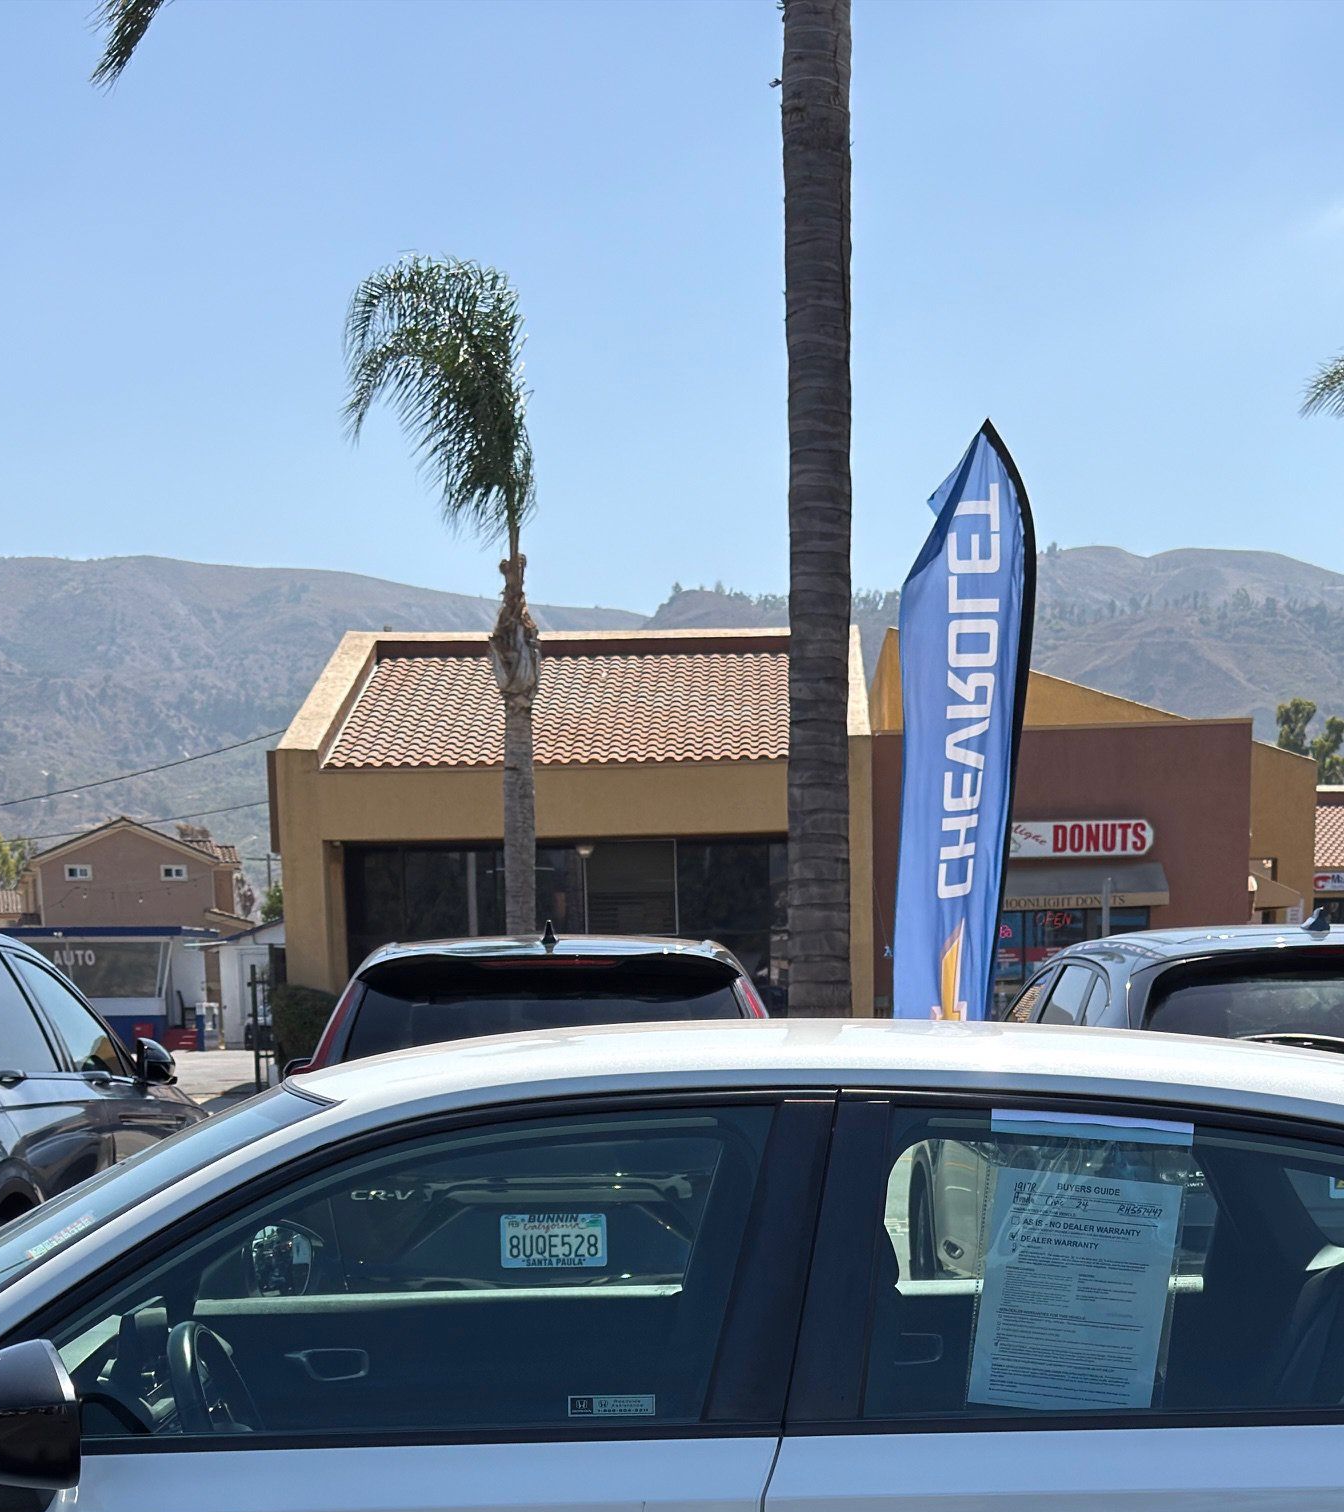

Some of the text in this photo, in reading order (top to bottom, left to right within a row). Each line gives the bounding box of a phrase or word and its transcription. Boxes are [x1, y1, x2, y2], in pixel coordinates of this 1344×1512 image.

[1052, 822, 1147, 853] DONUTS
[1076, 895, 1125, 907] DONTS
[1036, 911, 1072, 928] OPEN
[53, 949, 96, 967] AUTO
[351, 1190, 415, 1200] CR-V
[1057, 1182, 1121, 1197] BUYERS GUIDE
[528, 1214, 579, 1223] BUNNIN
[1023, 1218, 1034, 1226] AS
[1049, 1220, 1062, 1228] NO
[1063, 1222, 1094, 1232] DEALER
[1096, 1226, 1141, 1237] WARRANTY
[509, 1234, 598, 1258] 8UQE528
[1020, 1234, 1052, 1245] DEALER
[1054, 1238, 1099, 1250] WARRANTY
